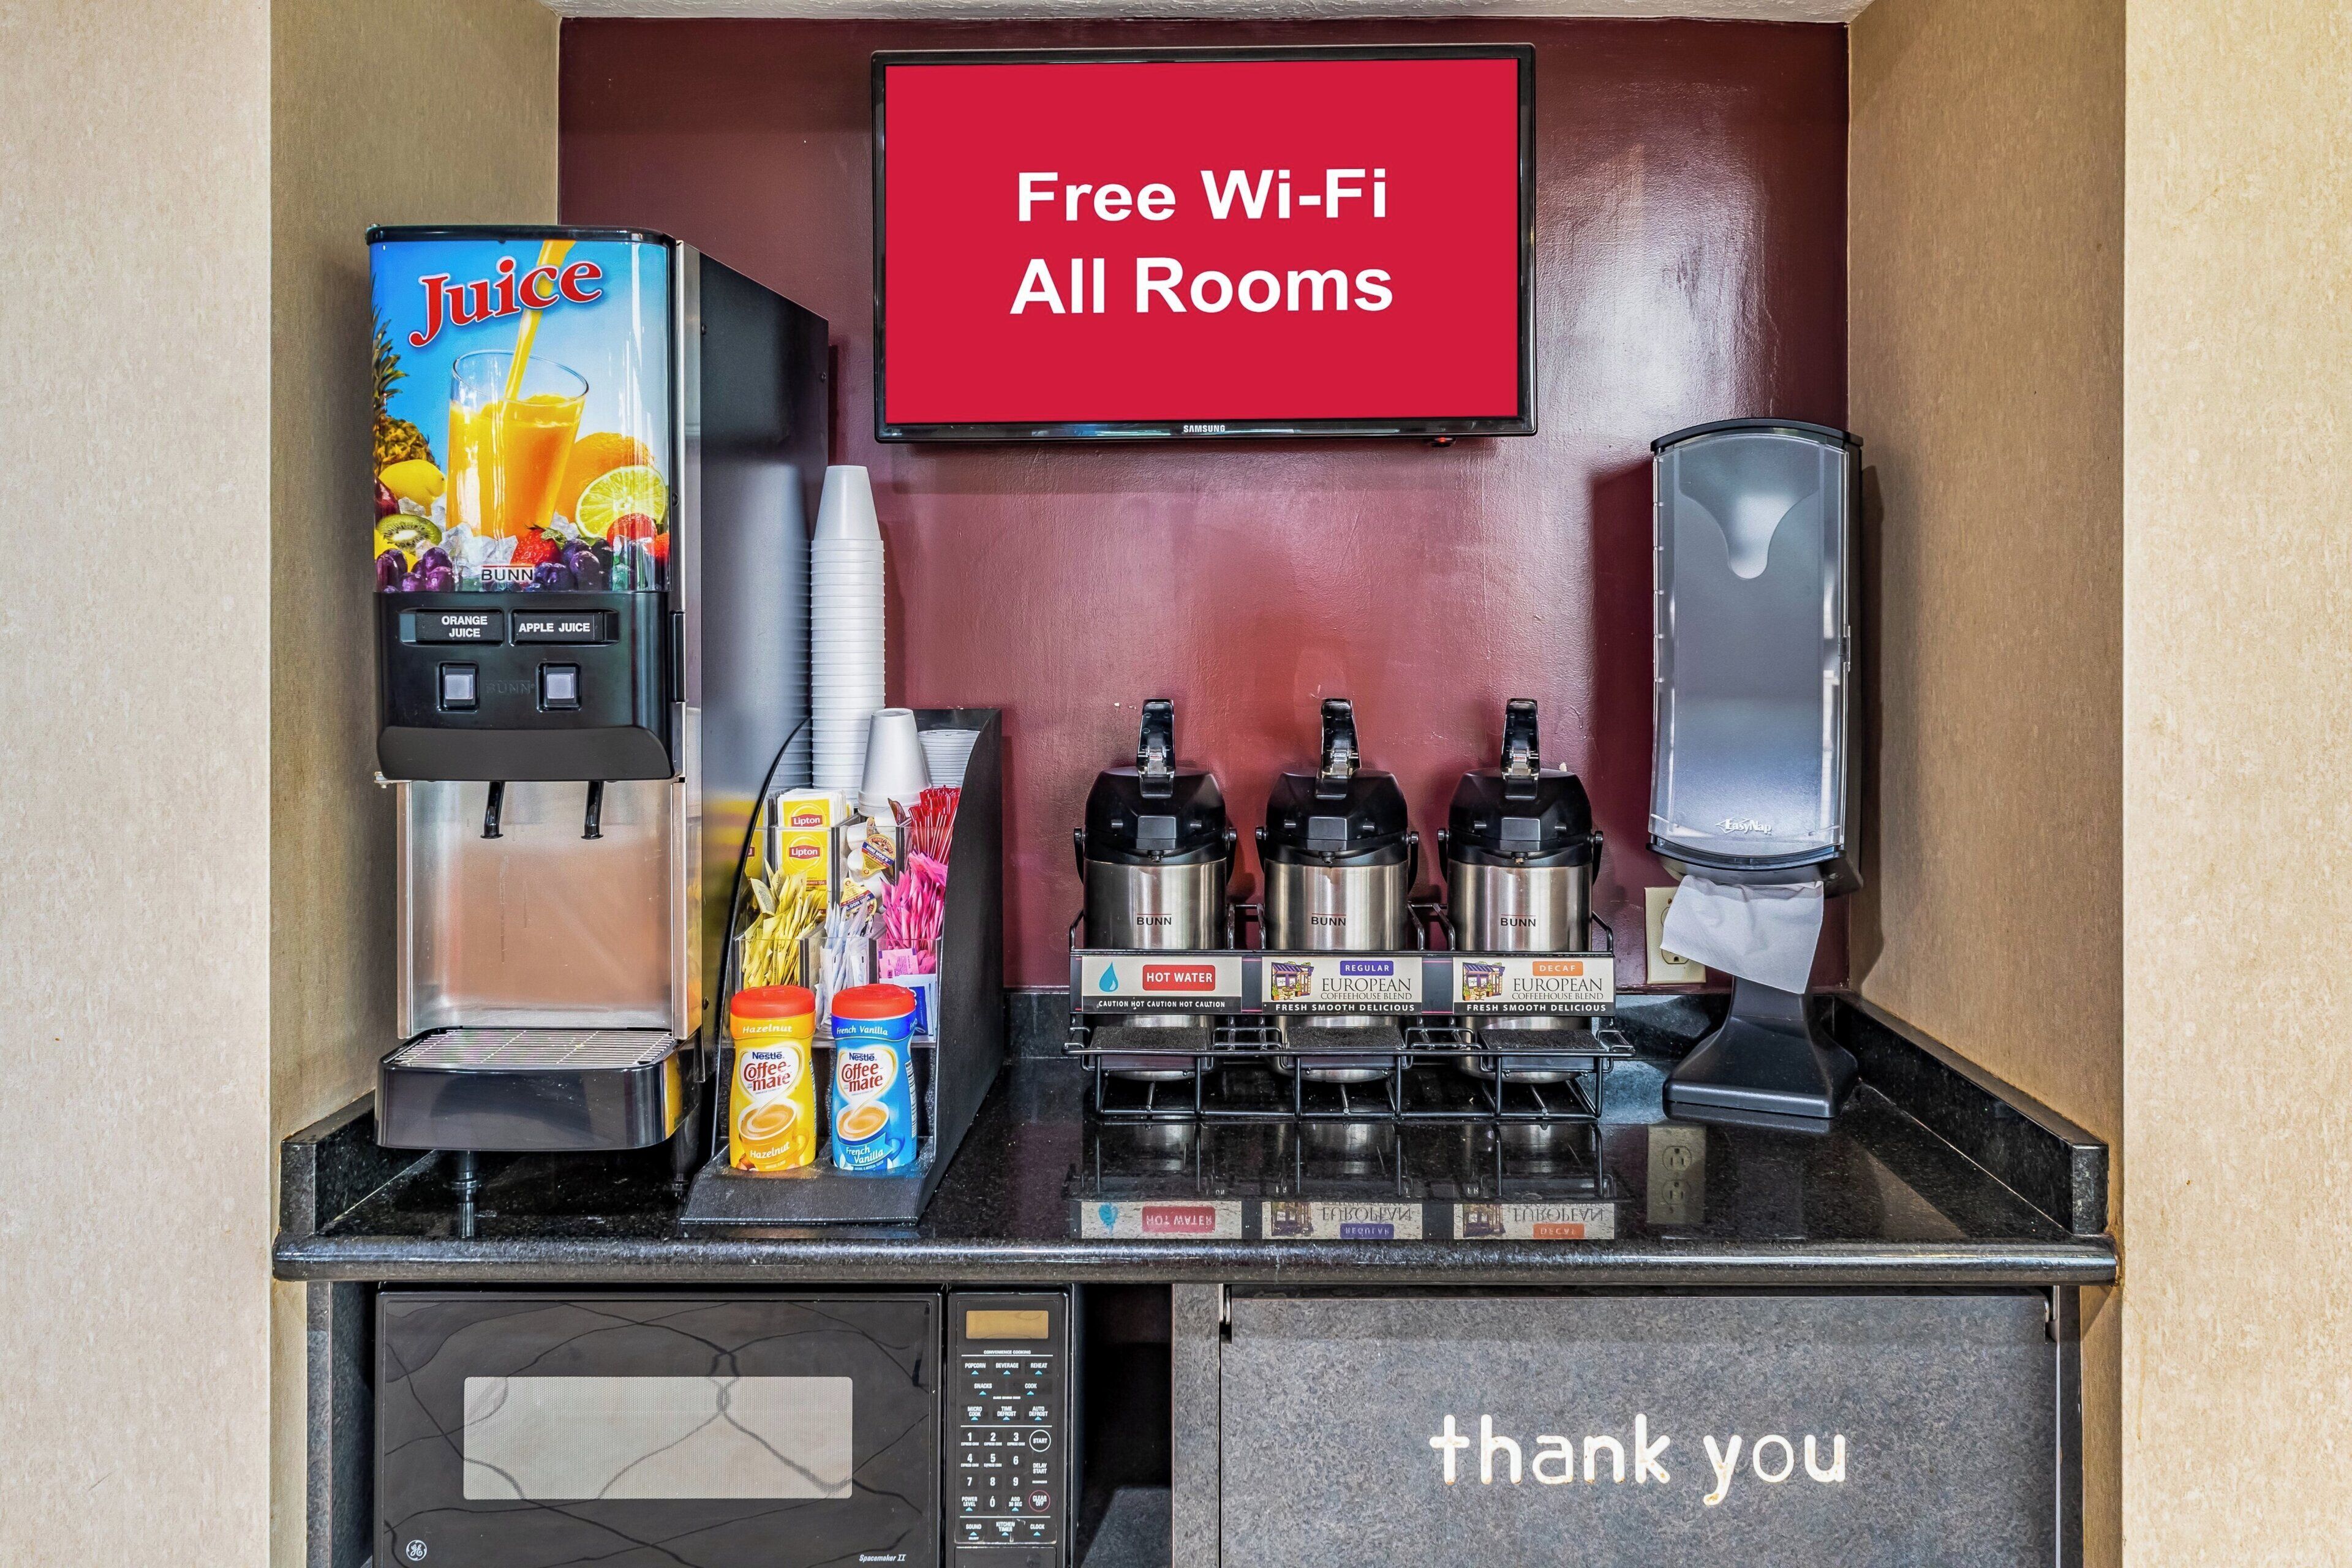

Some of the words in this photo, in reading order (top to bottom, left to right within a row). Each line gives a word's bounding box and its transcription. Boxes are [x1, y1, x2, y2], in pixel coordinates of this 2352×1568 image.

[1017, 171, 1176, 221] Free
[1200, 168, 1387, 220] Wi-Fi
[1010, 257, 1106, 314] All
[1135, 256, 1393, 314] Rooms
[409, 256, 603, 347] Juice
[1183, 424, 1226, 433] SAMSUNG
[481, 569, 533, 582] BUNN
[441, 616, 488, 626] ORANGE
[449, 627, 481, 638] JUICE
[519, 622, 554, 633] APPLE
[559, 622, 590, 633] JUICE
[485, 680, 531, 695] BUNN
[793, 817, 821, 826] Lipton
[1725, 818, 1772, 834] EasyNap
[791, 848, 818, 858] Lipton
[865, 845, 876, 854] MINI
[875, 852, 889, 862] MOO'S
[1137, 917, 1172, 925] BUNN
[1311, 916, 1346, 925] BUNN
[1501, 918, 1536, 927] BUNN
[1147, 972, 1170, 982] HOT
[1174, 972, 1213, 982] WATER
[1322, 978, 1411, 992] EUROPEAN
[1513, 978, 1602, 992] EUROPEAN
[742, 1023, 793, 1034] Hazelnut
[836, 1025, 856, 1034] French
[859, 1025, 888, 1035] Vanilla
[849, 1052, 875, 1061] Nestlé
[753, 1072, 791, 1091] mate
[849, 1075, 883, 1092] mate
[750, 1142, 790, 1158] Hazelnut
[846, 1145, 870, 1156] French
[854, 1149, 884, 1164] Vanilla
[967, 1432, 972, 1441] 1
[990, 1432, 996, 1441] 2
[1013, 1432, 1019, 1441] 3
[967, 1453, 973, 1463] 4
[990, 1453, 996, 1463] 5
[1013, 1455, 1019, 1465] 6
[1429, 1413, 1671, 1485] thank
[1703, 1434, 1846, 1507] you
[967, 1477, 973, 1486] 7
[990, 1477, 995, 1486] 8
[1012, 1477, 1019, 1486] 9
[989, 1498, 995, 1507] 0
[859, 1554, 896, 1562] Spacemaker
